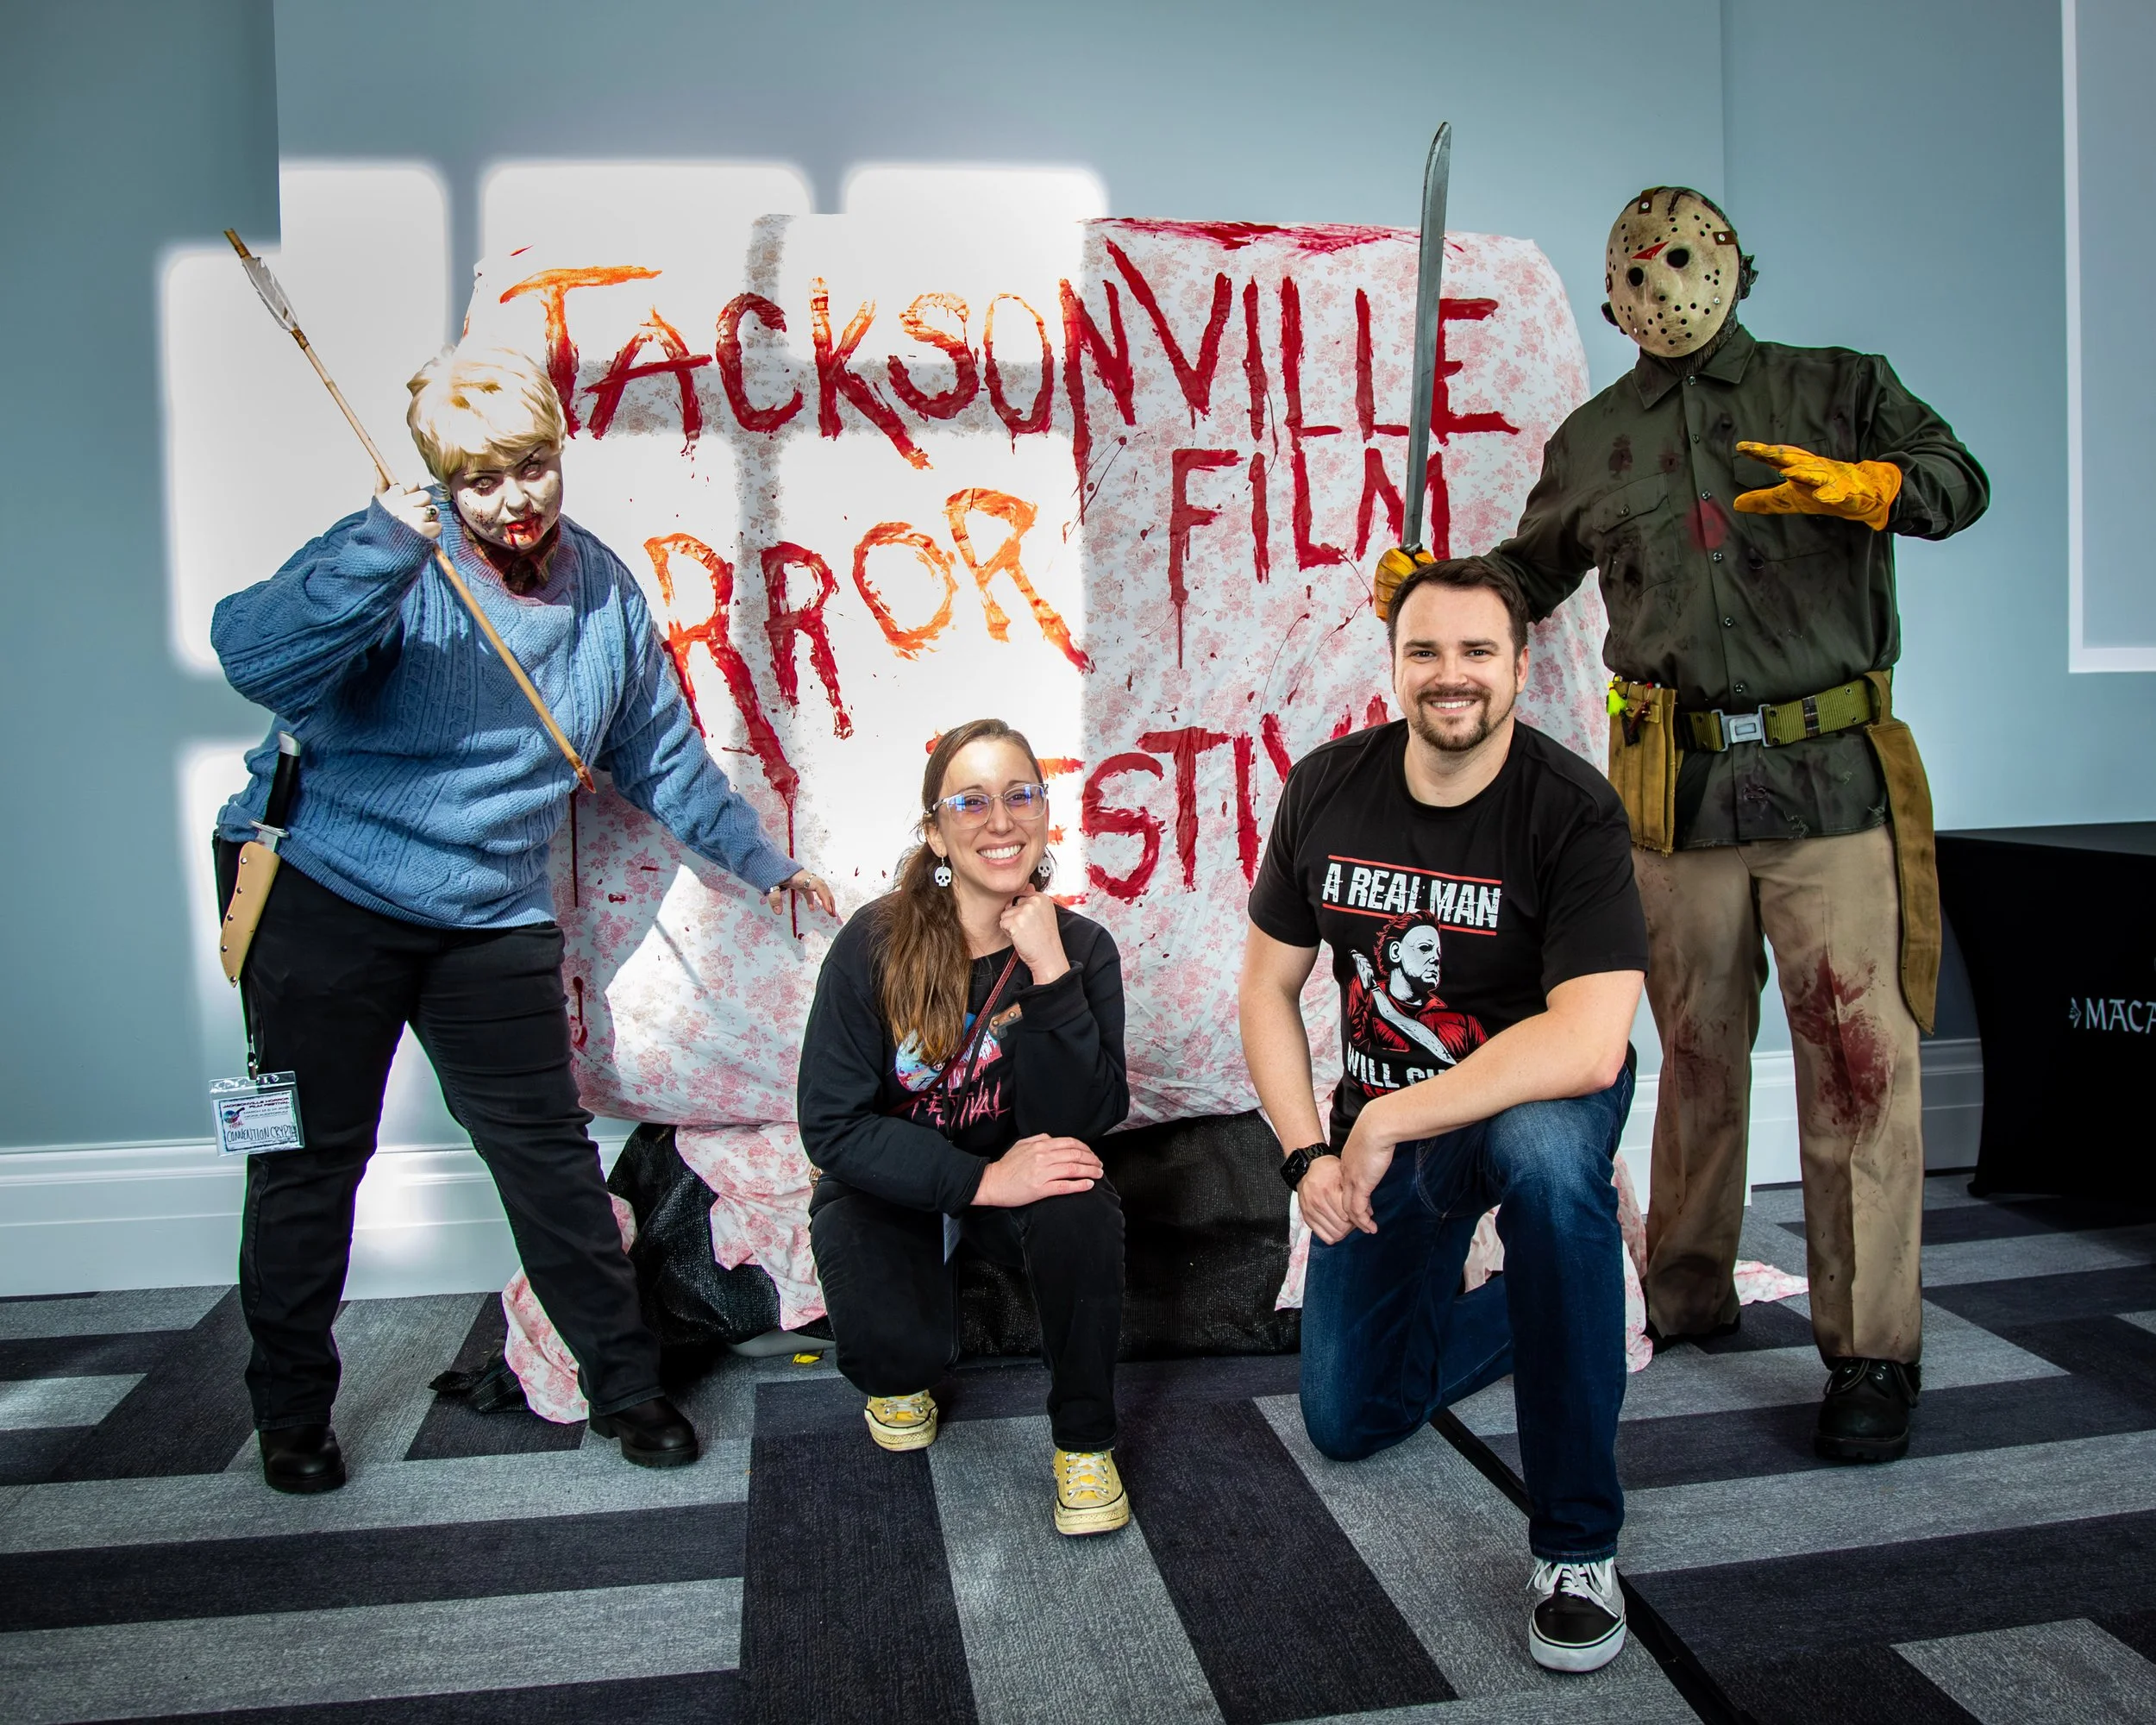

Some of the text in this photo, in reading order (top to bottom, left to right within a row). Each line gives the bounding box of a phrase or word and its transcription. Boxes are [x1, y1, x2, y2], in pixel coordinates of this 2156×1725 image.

[1168, 447, 1451, 606] FILM
[1322, 862, 1501, 928] A REAL MAN
[1347, 1041, 1400, 1088] WILL
